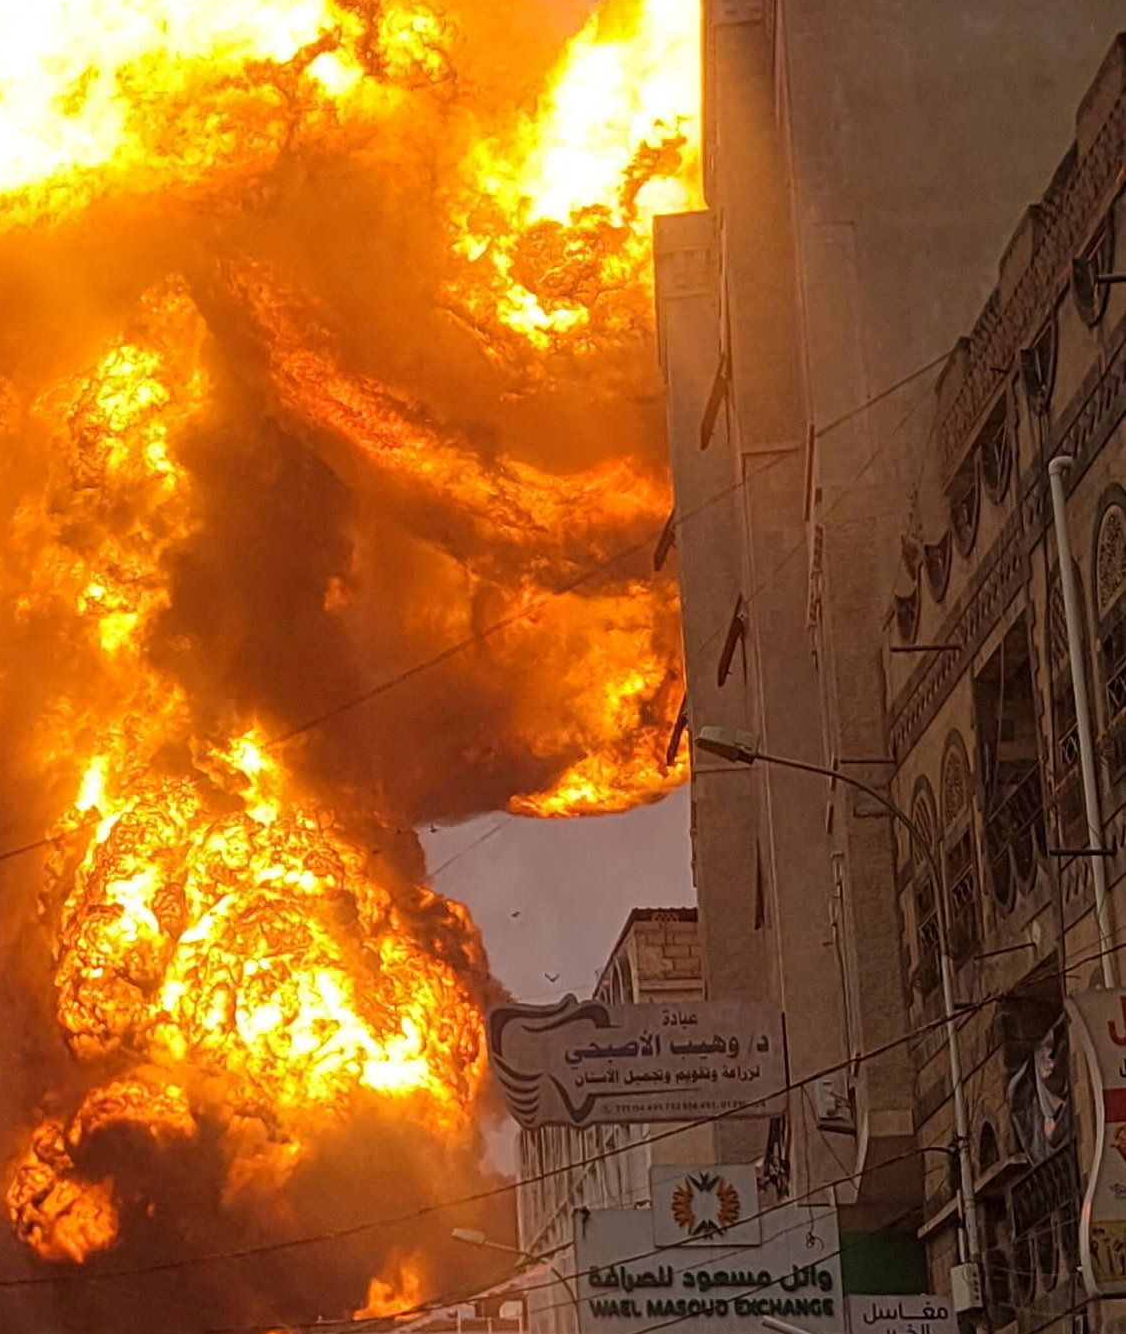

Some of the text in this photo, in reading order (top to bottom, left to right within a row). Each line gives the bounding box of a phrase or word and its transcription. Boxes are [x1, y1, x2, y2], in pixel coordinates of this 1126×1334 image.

[662, 1009, 698, 1029] عيادة
[564, 1030, 661, 1069] الأصبحي
[669, 1033, 740, 1060] وهيب
[624, 1068, 671, 1086] وتجميل
[675, 1068, 718, 1084] وتقويم
[722, 1065, 761, 1083] لزراعة
[588, 1265, 833, 1293] وائل مسعود للصرافة
[589, 1298, 836, 1317] WAEL MASOUD EXCHANGE
[863, 1301, 948, 1325] مغاسل
